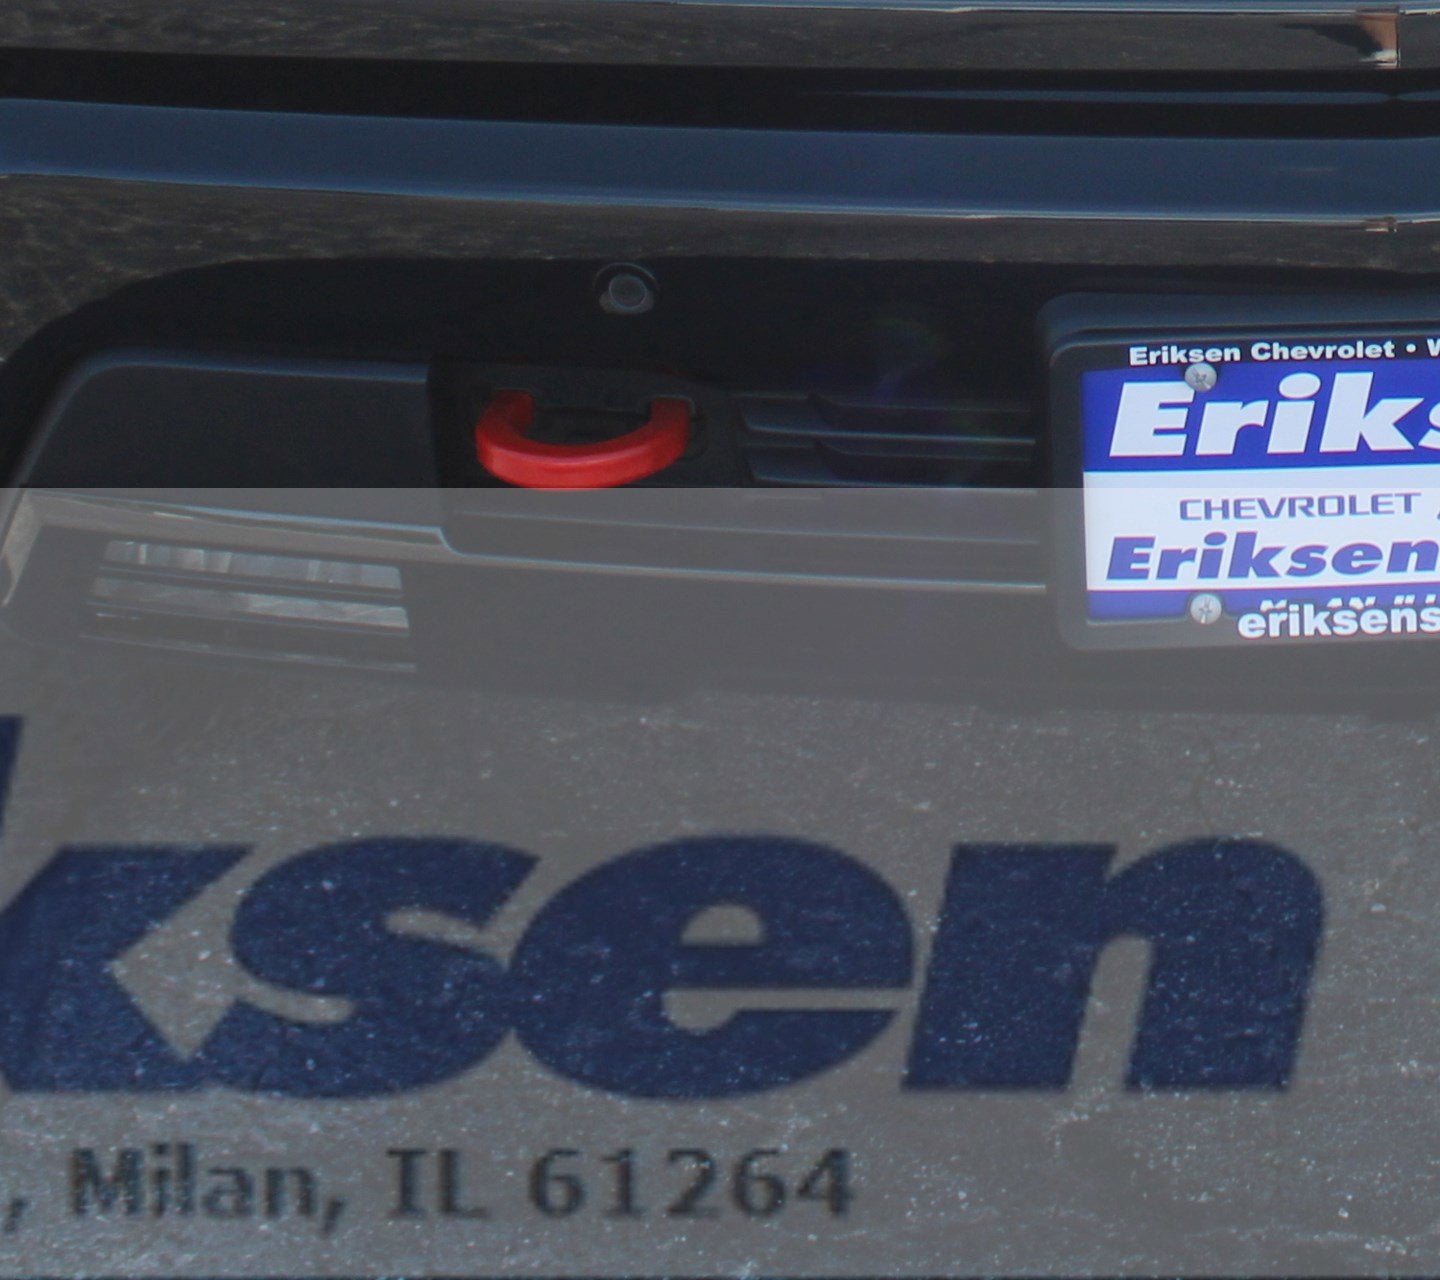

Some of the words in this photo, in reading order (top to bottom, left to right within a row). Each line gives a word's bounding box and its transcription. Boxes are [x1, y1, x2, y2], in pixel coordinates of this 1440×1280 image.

[1128, 345, 1241, 366] Eriksen
[1250, 340, 1395, 361] Chevrolet
[1179, 492, 1421, 521] CHEVROLET
